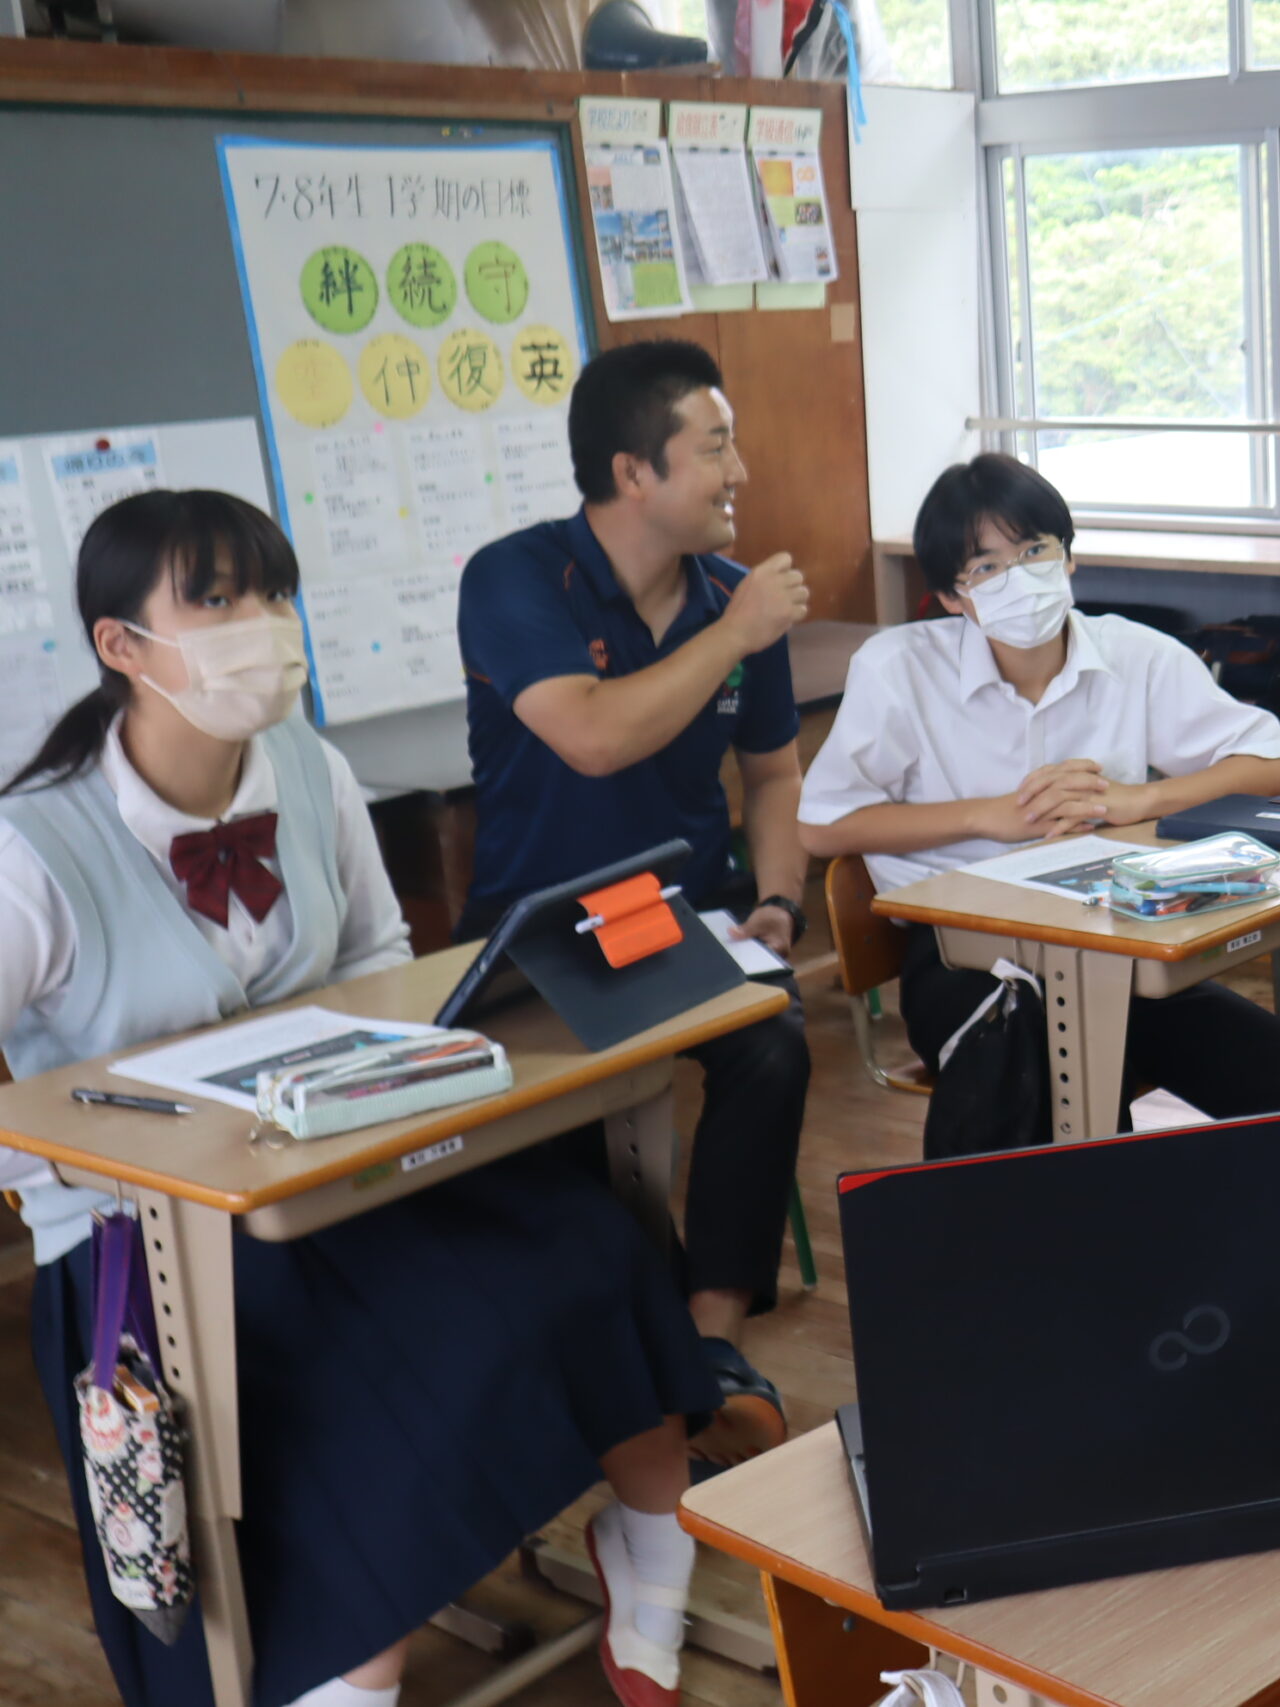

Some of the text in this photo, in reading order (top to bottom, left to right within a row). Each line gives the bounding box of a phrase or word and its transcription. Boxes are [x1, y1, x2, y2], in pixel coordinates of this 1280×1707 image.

[318, 256, 363, 315] 絆
[399, 256, 447, 312] 続
[478, 256, 516, 315] 守
[373, 354, 421, 407] 仲
[448, 343, 494, 396] 復
[520, 342, 564, 393] 英
